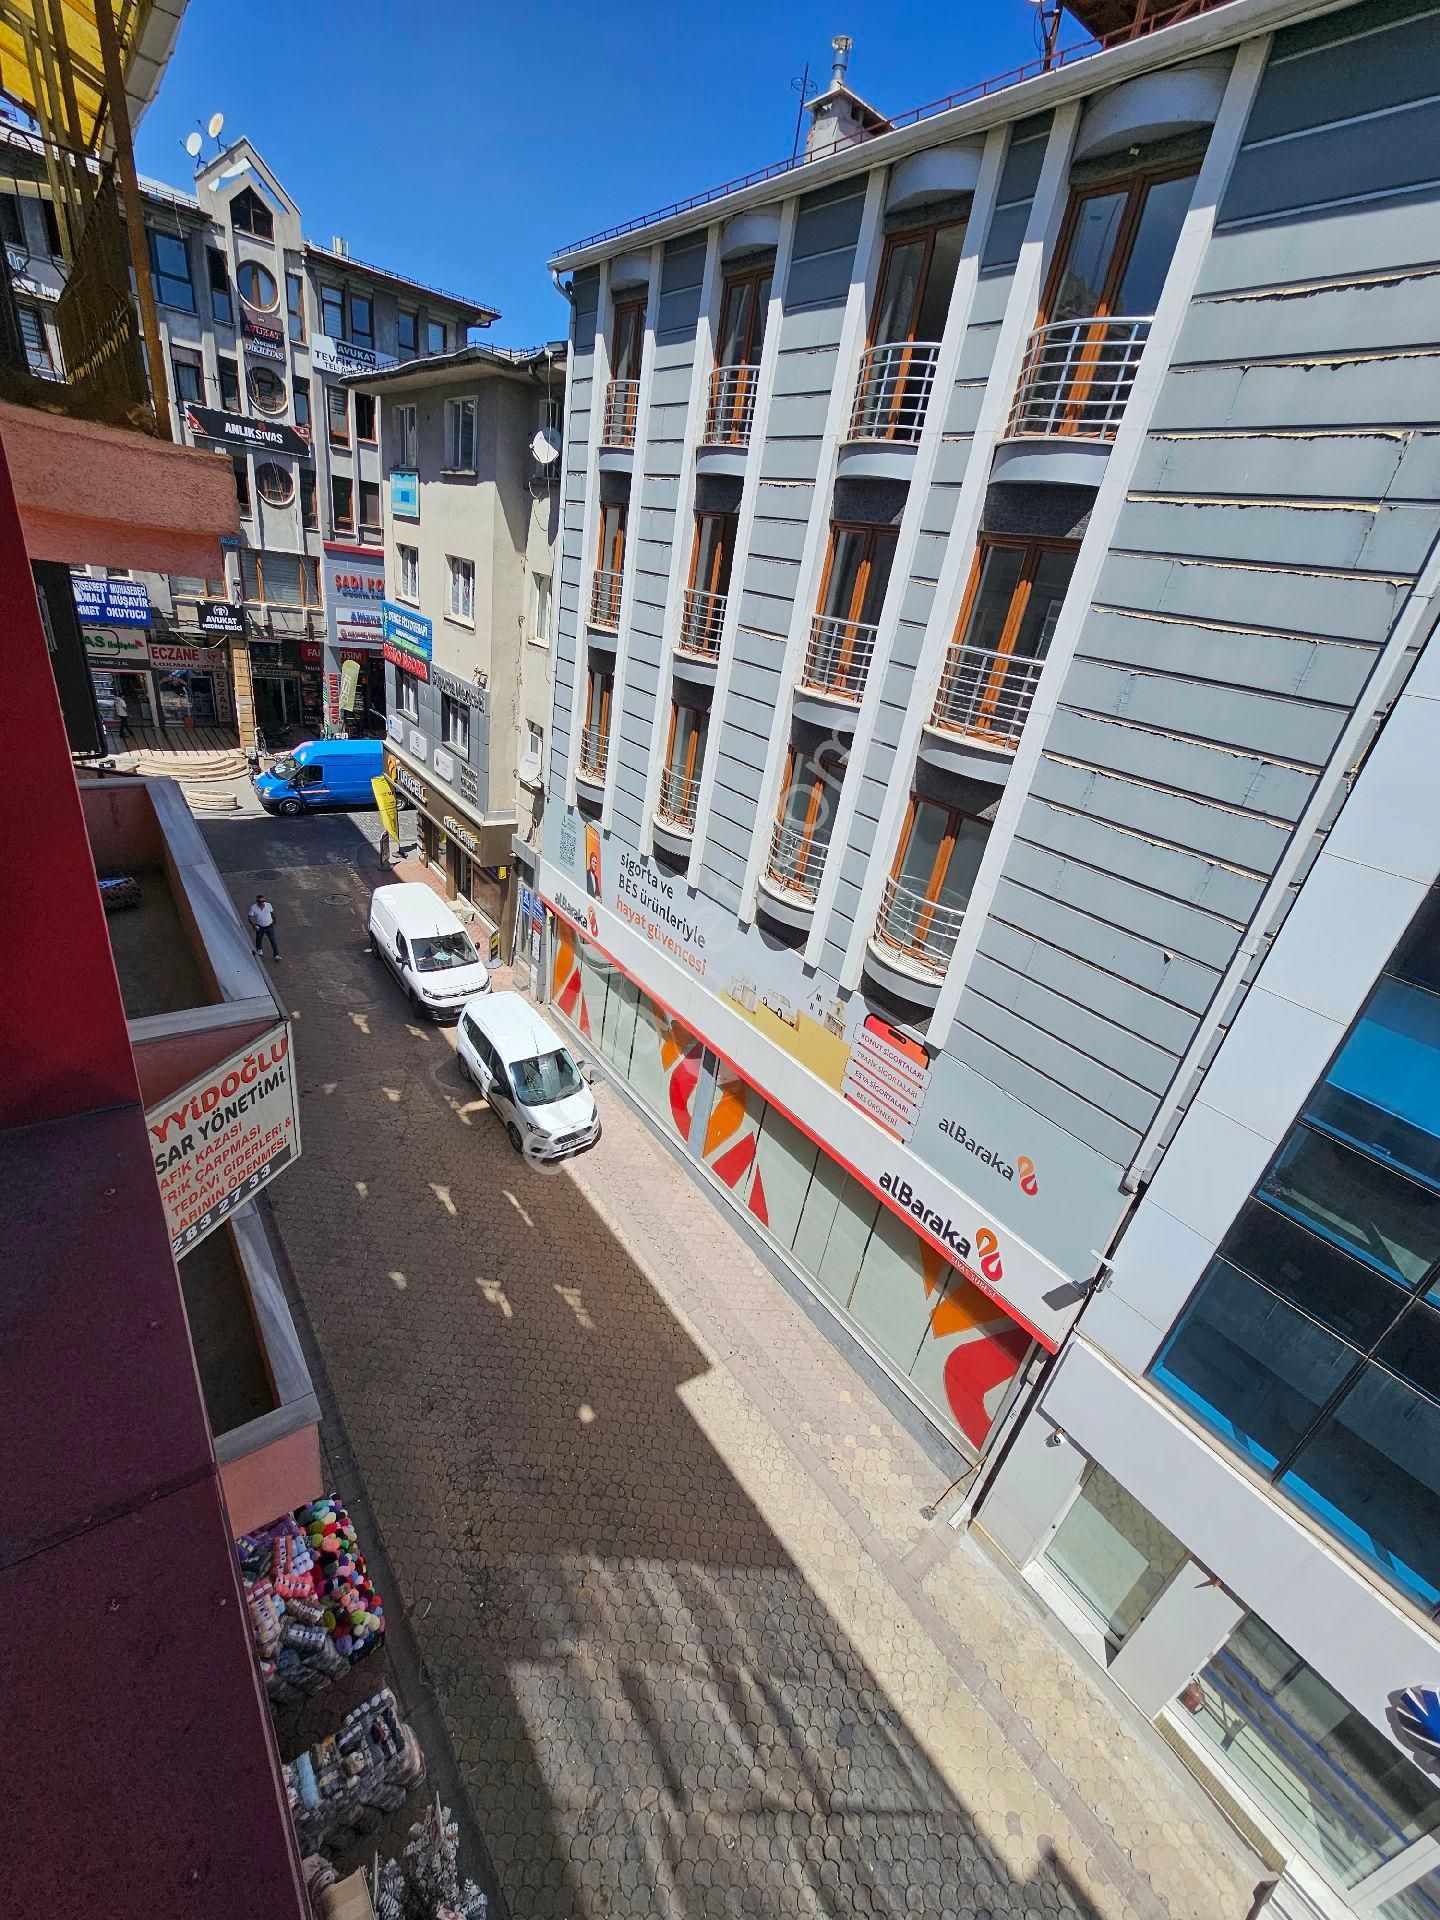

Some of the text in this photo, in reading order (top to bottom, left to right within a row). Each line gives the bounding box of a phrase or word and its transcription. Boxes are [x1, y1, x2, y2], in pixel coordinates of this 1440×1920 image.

[337, 345, 376, 362] AVUKAT
[206, 615, 238, 625] AVUKAT
[151, 646, 200, 661] ECZANE
[215, 672, 227, 719] ECZANE
[620, 853, 674, 899] sigorta ve
[554, 892, 588, 930] alBaraka
[616, 895, 707, 976] hayat güvencesi
[618, 874, 706, 949] BES ürünleriyle
[860, 1032, 884, 1054] KONUT
[149, 1037, 289, 1143] YYİDOĞLU
[198, 1066, 287, 1141] YÖNETİMİ
[172, 1117, 292, 1217] TEDAVİ GİDERLERİ &
[195, 1121, 243, 1165] KAZASI
[195, 1123, 262, 1184] ÇARPMASI
[228, 1135, 288, 1189] ÖDENMESİ
[938, 1117, 1015, 1182] alBaraka
[878, 1171, 971, 1260] alBaraka
